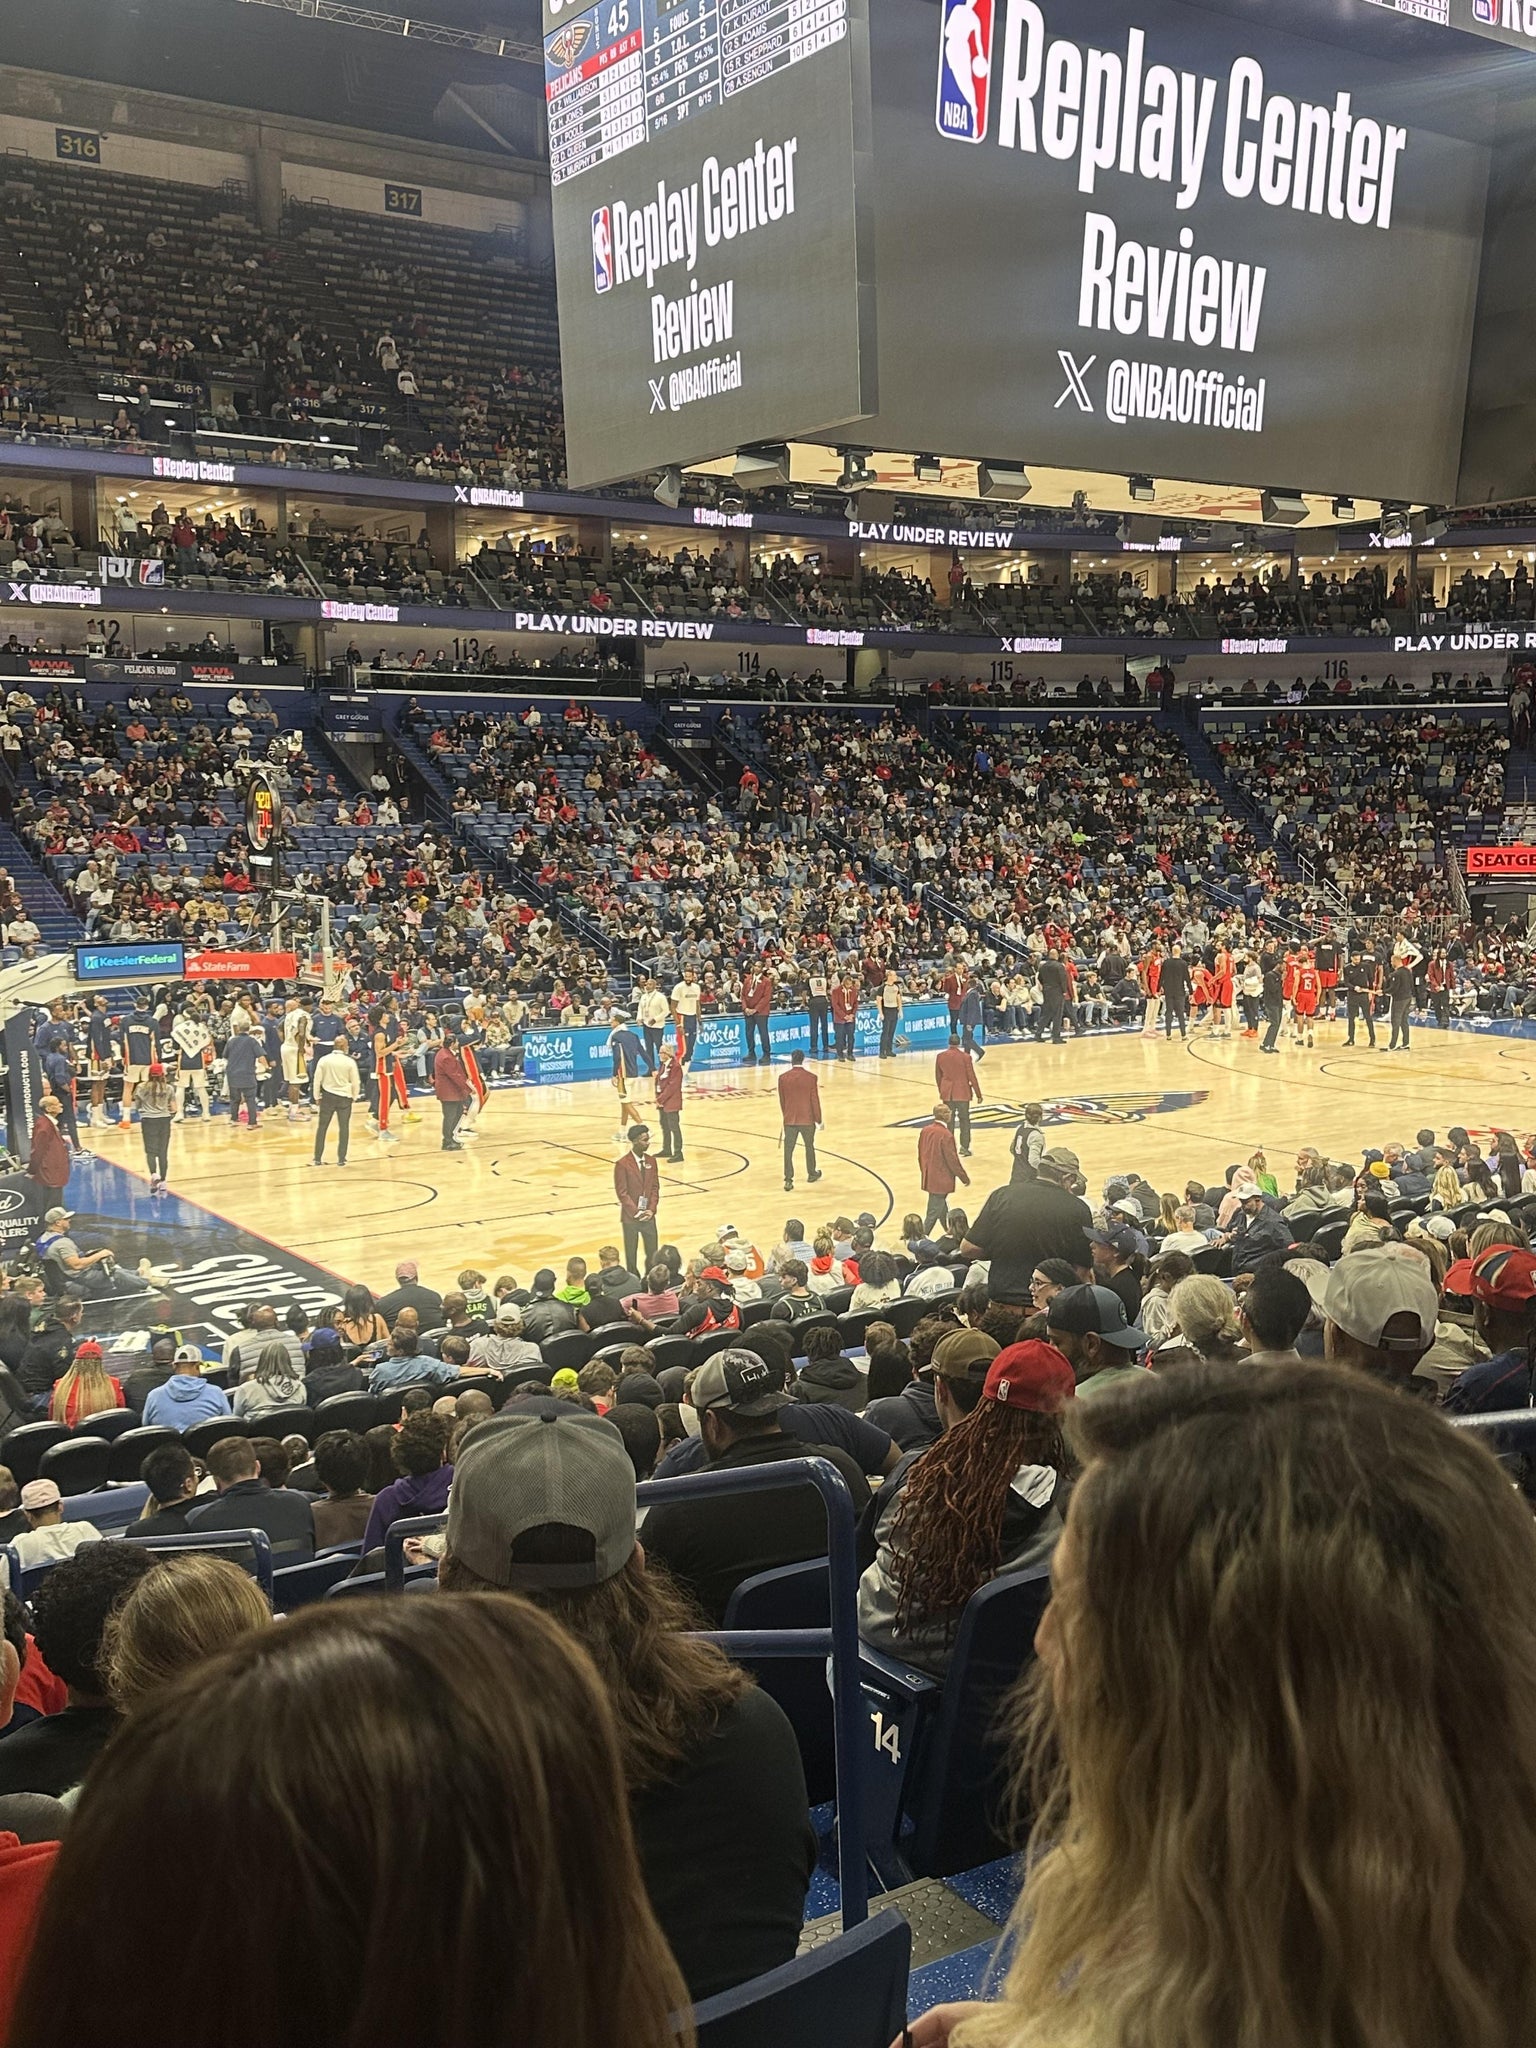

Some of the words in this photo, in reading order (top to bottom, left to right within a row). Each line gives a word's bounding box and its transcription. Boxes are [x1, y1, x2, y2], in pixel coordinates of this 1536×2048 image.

[607, 0, 629, 36] 45
[742, 1, 770, 25] DURANT
[653, 27, 660, 44] 5
[669, 9, 689, 33] FOULS
[725, 41, 733, 54] 12
[742, 22, 767, 45] ADAMS
[654, 48, 661, 65] 5
[699, 22, 707, 40] 5
[744, 34, 782, 64] SHEPPARD
[550, 65, 583, 98] PELICANS
[563, 80, 598, 106] WILLIAMSON
[678, 80, 686, 97] FT
[565, 106, 583, 124] JONES
[677, 101, 689, 121] 3PT
[943, 99, 969, 132] NBA
[998, 0, 1217, 210] Replay
[1222, 55, 1407, 230] Center
[564, 123, 583, 142] POOLE
[60, 133, 97, 157] 316
[388, 190, 419, 210] 317
[612, 180, 698, 289] Replay
[702, 136, 798, 247] Center
[1078, 210, 1267, 354] Review
[652, 278, 734, 363] Review
[174, 383, 193, 394] 316
[668, 350, 742, 412] @NBAOfficial
[302, 397, 320, 408] 316
[1105, 358, 1266, 432] @NBAOfficial
[360, 404, 375, 414] 317
[163, 457, 199, 480] Replay
[199, 461, 236, 482] Center
[470, 487, 524, 507] @NBAOfficial
[848, 521, 890, 540] PLAY
[892, 525, 945, 545] UNDER
[949, 529, 1013, 548] REVIEW
[30, 584, 101, 604] @NBAOfficial
[87, 618, 121, 655] 12
[515, 612, 568, 632] PLAY
[571, 616, 638, 637] UNDER
[641, 620, 714, 640] REVIEW
[452, 636, 480, 661] 113
[1394, 635, 1446, 652] PLAY
[1450, 633, 1520, 650] UNDER
[124, 664, 155, 675] PELICANS
[156, 665, 176, 676] RADIO
[738, 651, 761, 673] 114
[990, 660, 1014, 681] 115
[1324, 659, 1349, 679] 116
[1304, 978, 1312, 990] 15
[776, 1028, 789, 1043] SOME
[525, 1037, 573, 1059] Coastal
[589, 1046, 598, 1059] GO
[710, 1046, 740, 1058] MISSISSIPPI
[539, 1060, 574, 1072] MISSISSIPPI
[870, 1711, 902, 1765] 14
